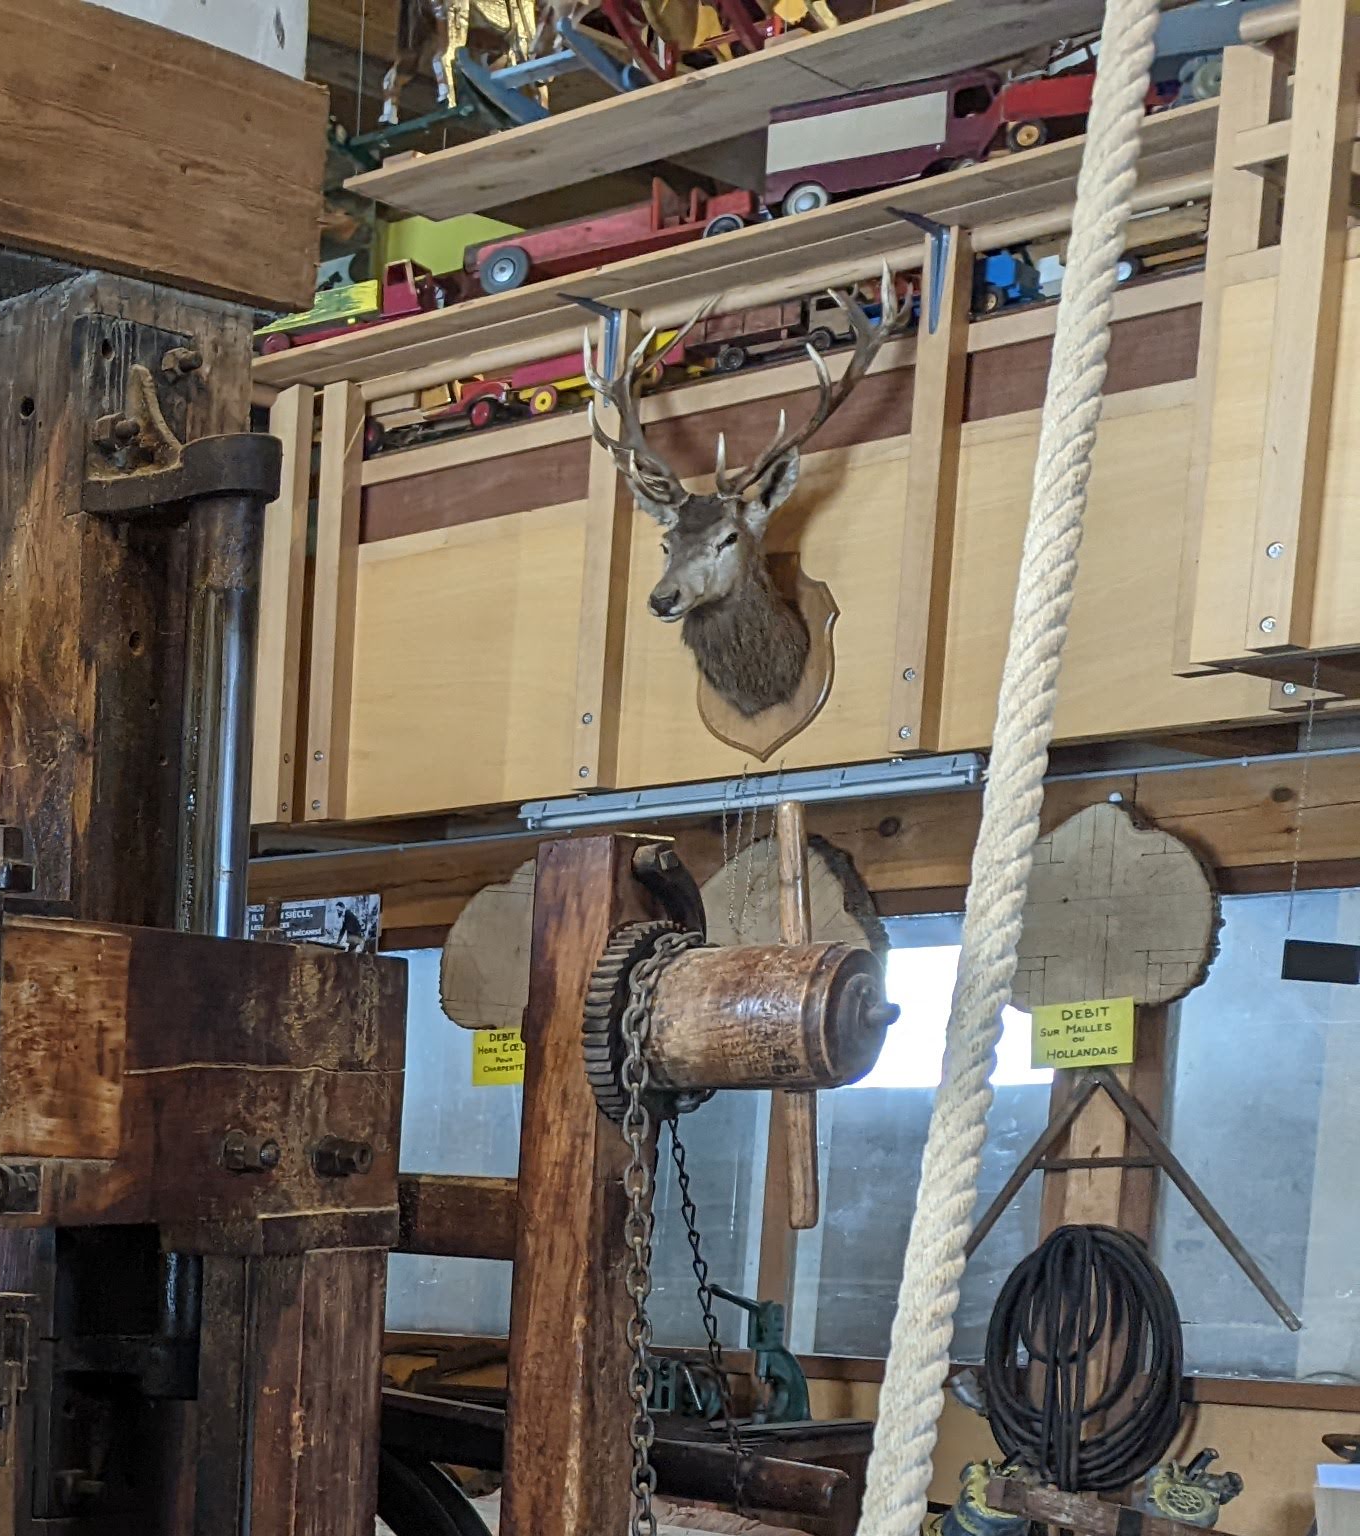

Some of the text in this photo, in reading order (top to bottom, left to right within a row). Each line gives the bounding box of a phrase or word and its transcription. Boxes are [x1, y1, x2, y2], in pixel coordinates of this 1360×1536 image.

[1061, 1006, 1110, 1021] DEBIT
[1066, 1022, 1112, 1035] MAILLES
[489, 1032, 515, 1042] DEBIT
[1046, 1046, 1118, 1060] HOLLANDAIS
